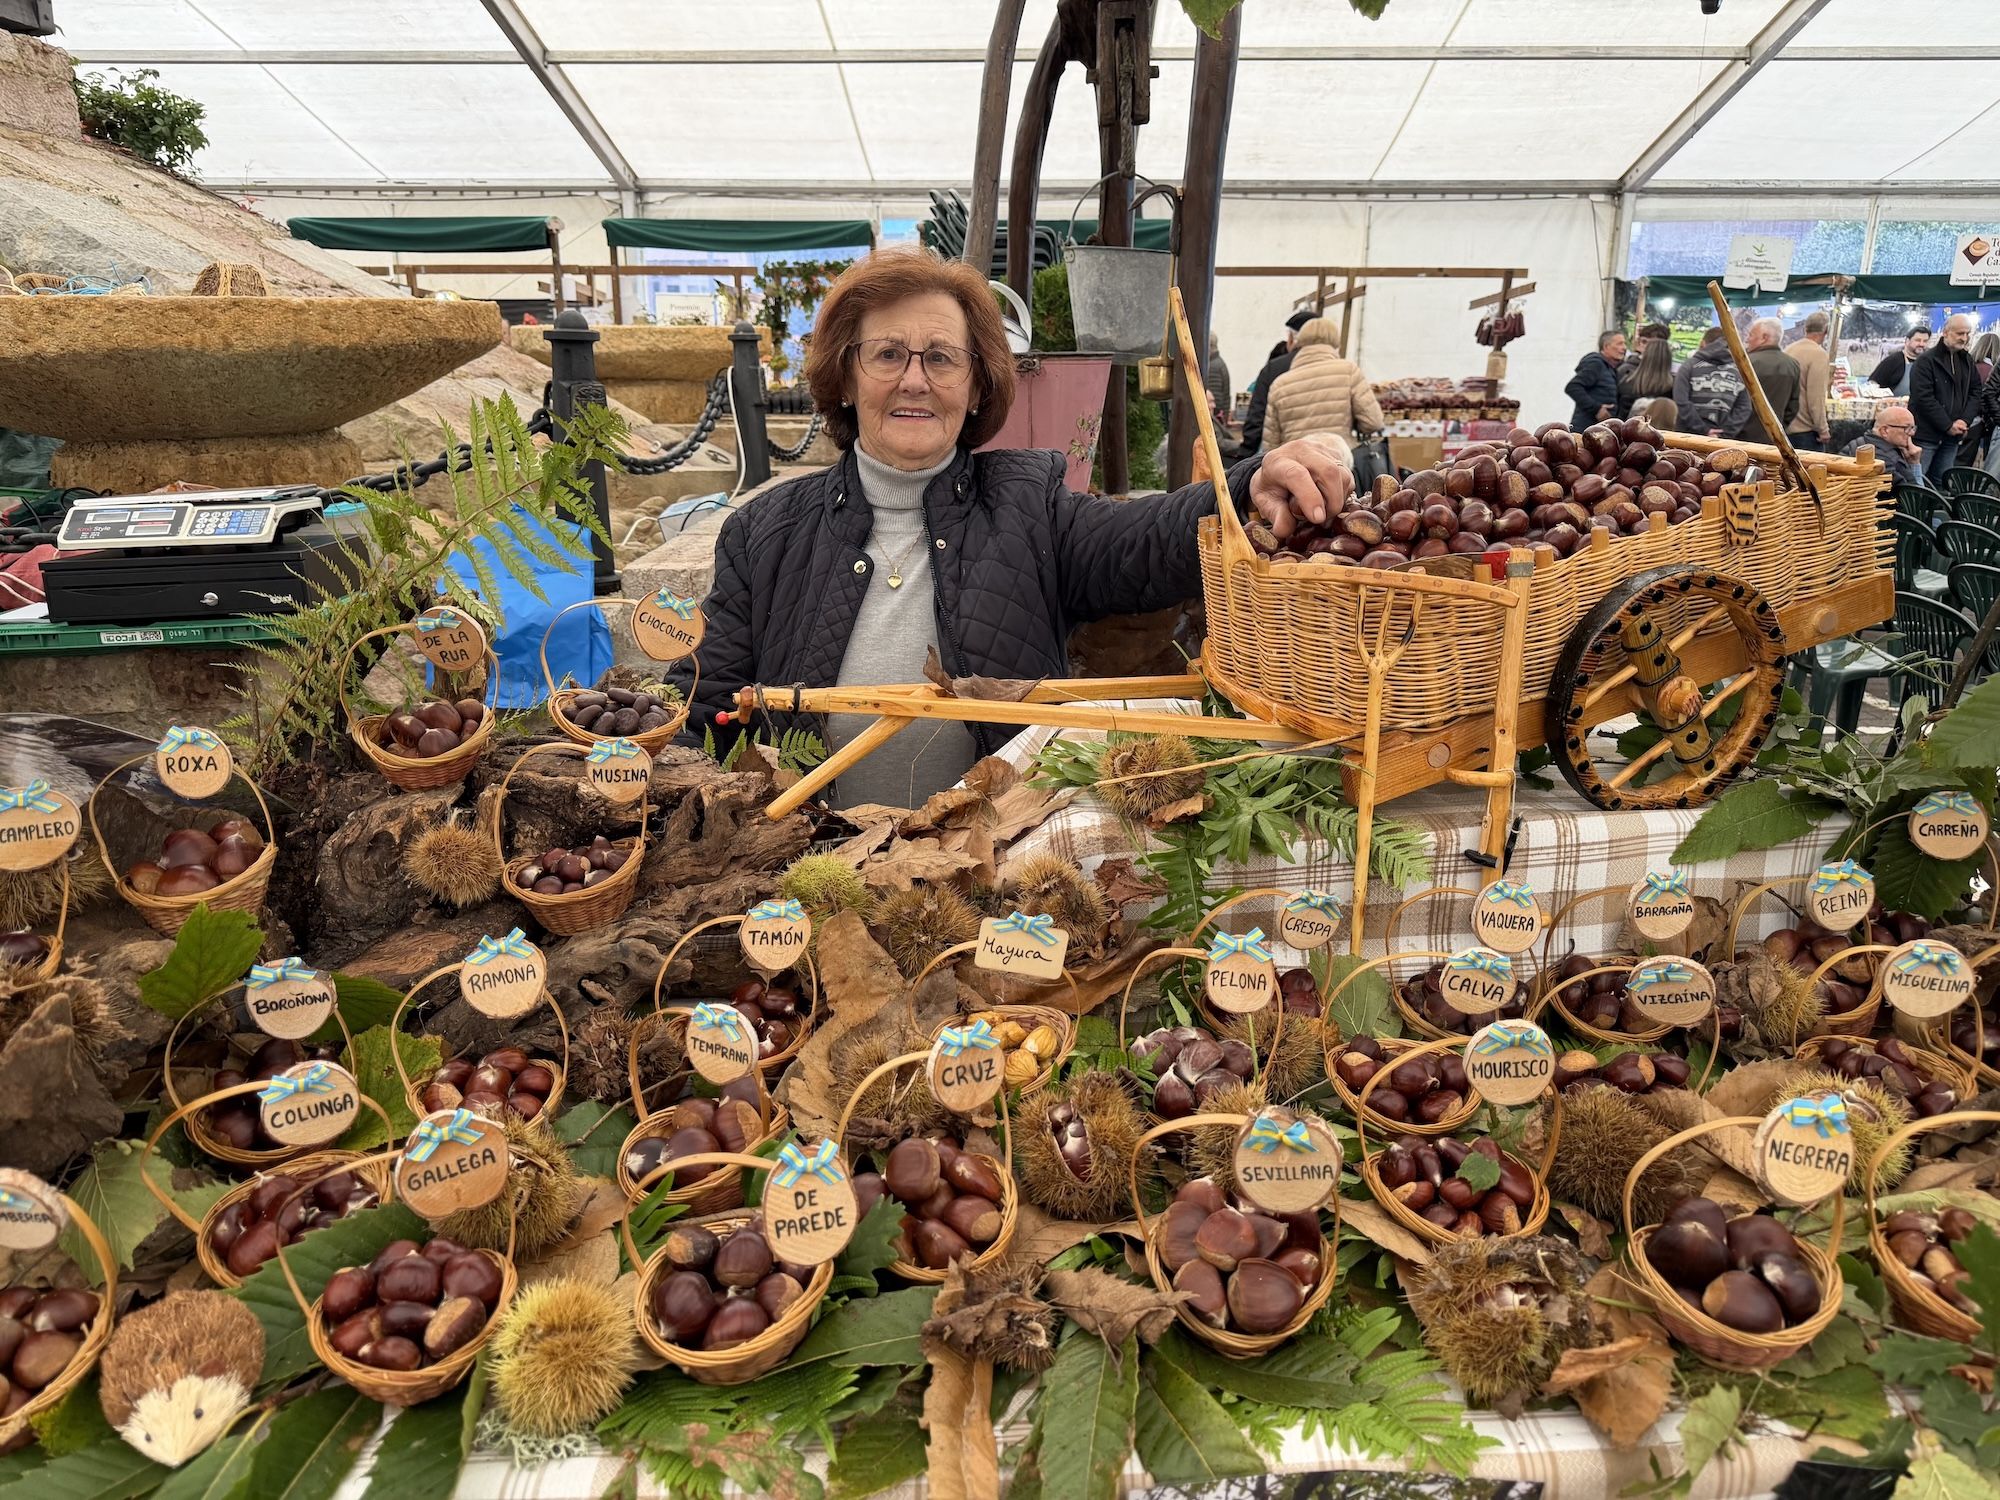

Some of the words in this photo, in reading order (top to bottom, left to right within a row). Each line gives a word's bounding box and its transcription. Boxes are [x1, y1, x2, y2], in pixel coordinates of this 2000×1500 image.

[422, 634, 443, 649] DE
[449, 630, 470, 644] LA
[638, 611, 697, 648] CHOCOLATE
[438, 648, 470, 664] RUA
[165, 755, 218, 775] ROXA
[592, 768, 648, 783] MUSINA
[0, 820, 75, 843] CAMPLERO
[1918, 819, 1980, 838] CARREÑA
[1634, 902, 1694, 919] BARAGAÑA
[1816, 887, 1869, 917] REINA
[1284, 916, 1333, 938] CRESPA
[1481, 910, 1536, 932] VAQUERA
[748, 927, 804, 946] TAMÓN
[982, 937, 1053, 965] Mayuca
[466, 963, 537, 994] RAMONA
[1209, 969, 1268, 993] PELONA
[1448, 974, 1505, 1002] CALVA
[1889, 971, 1970, 994] MIGUELINA
[252, 991, 331, 1015] BOROÑONA
[1637, 988, 1711, 1005] VIZCAÍNA
[690, 1036, 750, 1065] TEMPRANA
[941, 1057, 998, 1088] CRUZ
[1471, 1058, 1549, 1080] MOURISCO
[270, 1093, 355, 1129] COLUNGA
[1768, 1136, 1851, 1177] NEGRERA
[406, 1147, 497, 1192] GALLEGA
[1242, 1165, 1335, 1183] SEVILLANA
[794, 1189, 819, 1210] DE
[773, 1206, 848, 1239] PAREDE
